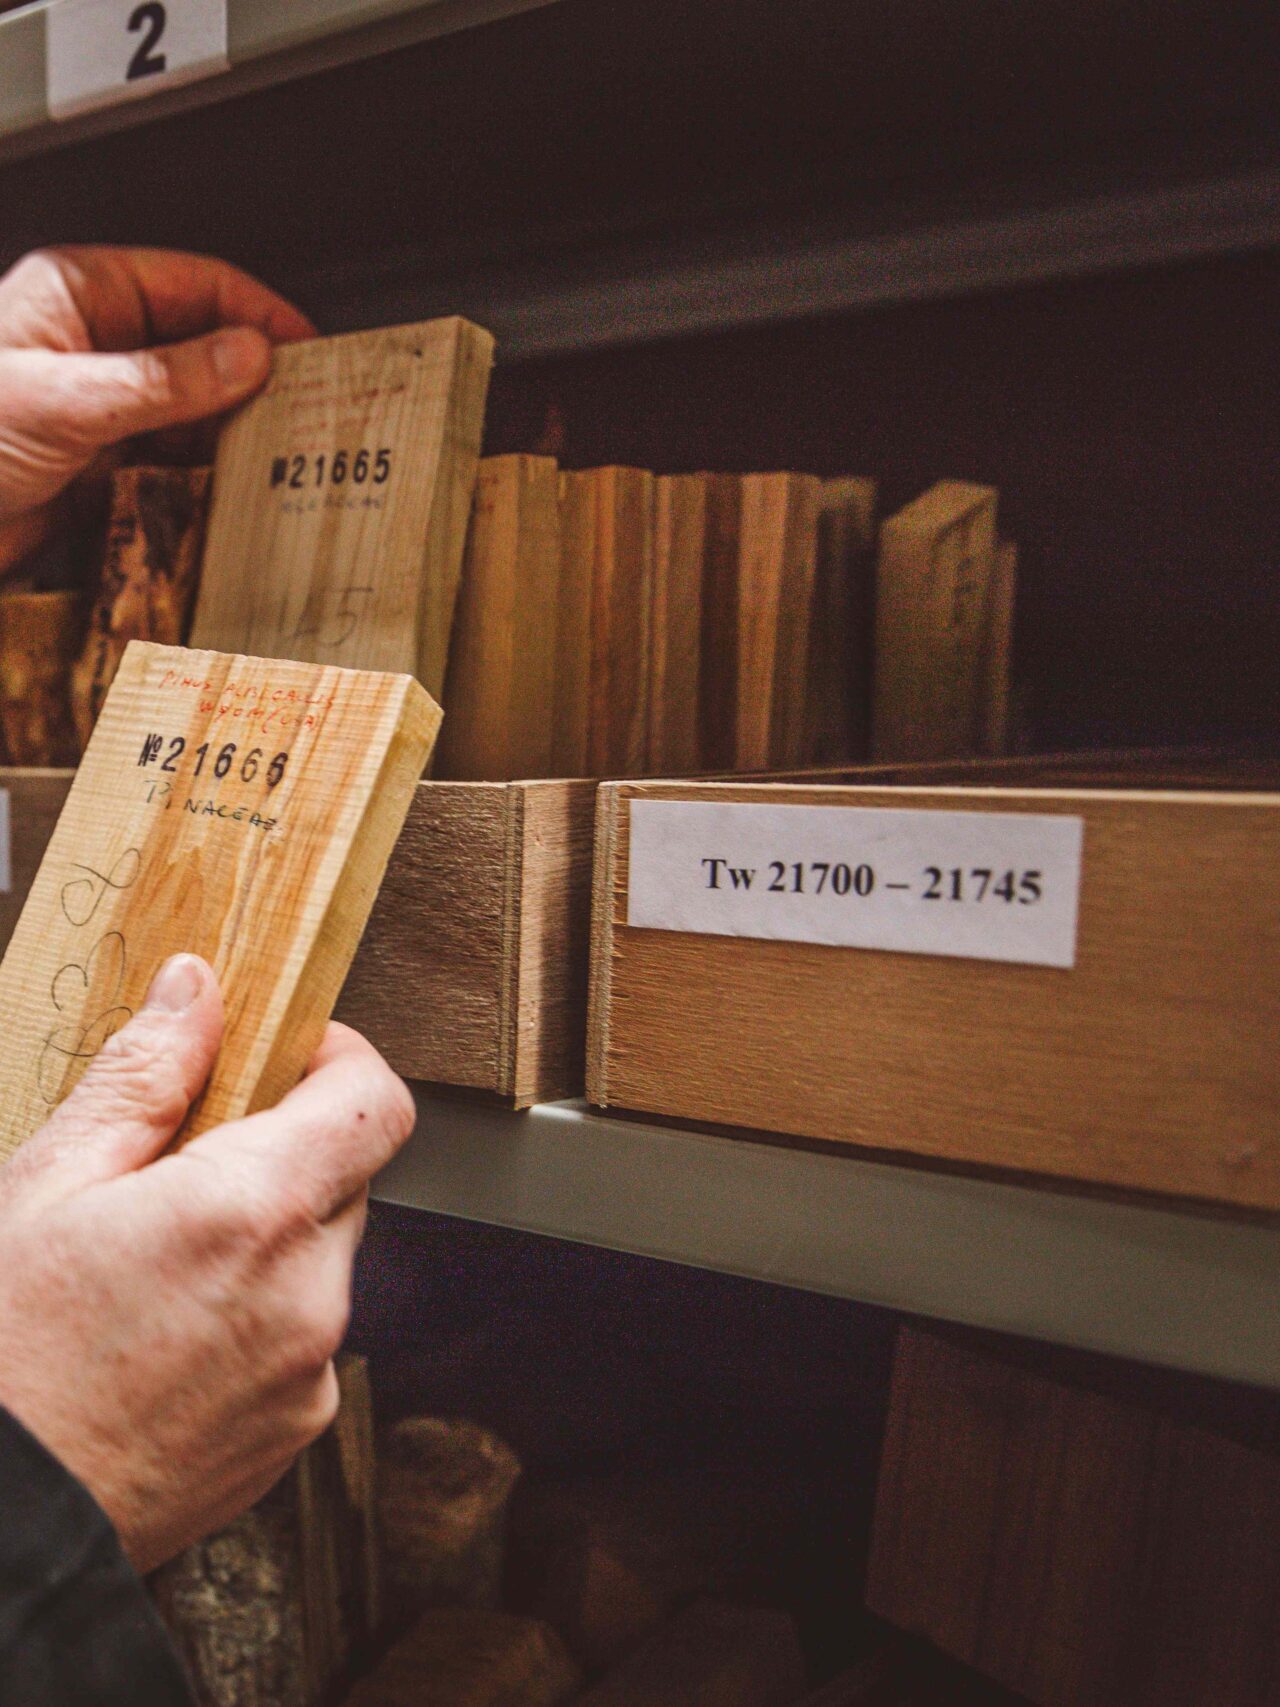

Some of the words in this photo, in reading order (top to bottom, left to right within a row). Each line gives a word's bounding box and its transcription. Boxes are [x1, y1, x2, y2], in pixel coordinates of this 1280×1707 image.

[126, 2, 166, 81] 2
[701, 857, 756, 892] Tw
[766, 860, 875, 897] 21700
[921, 864, 1043, 904] 21745
